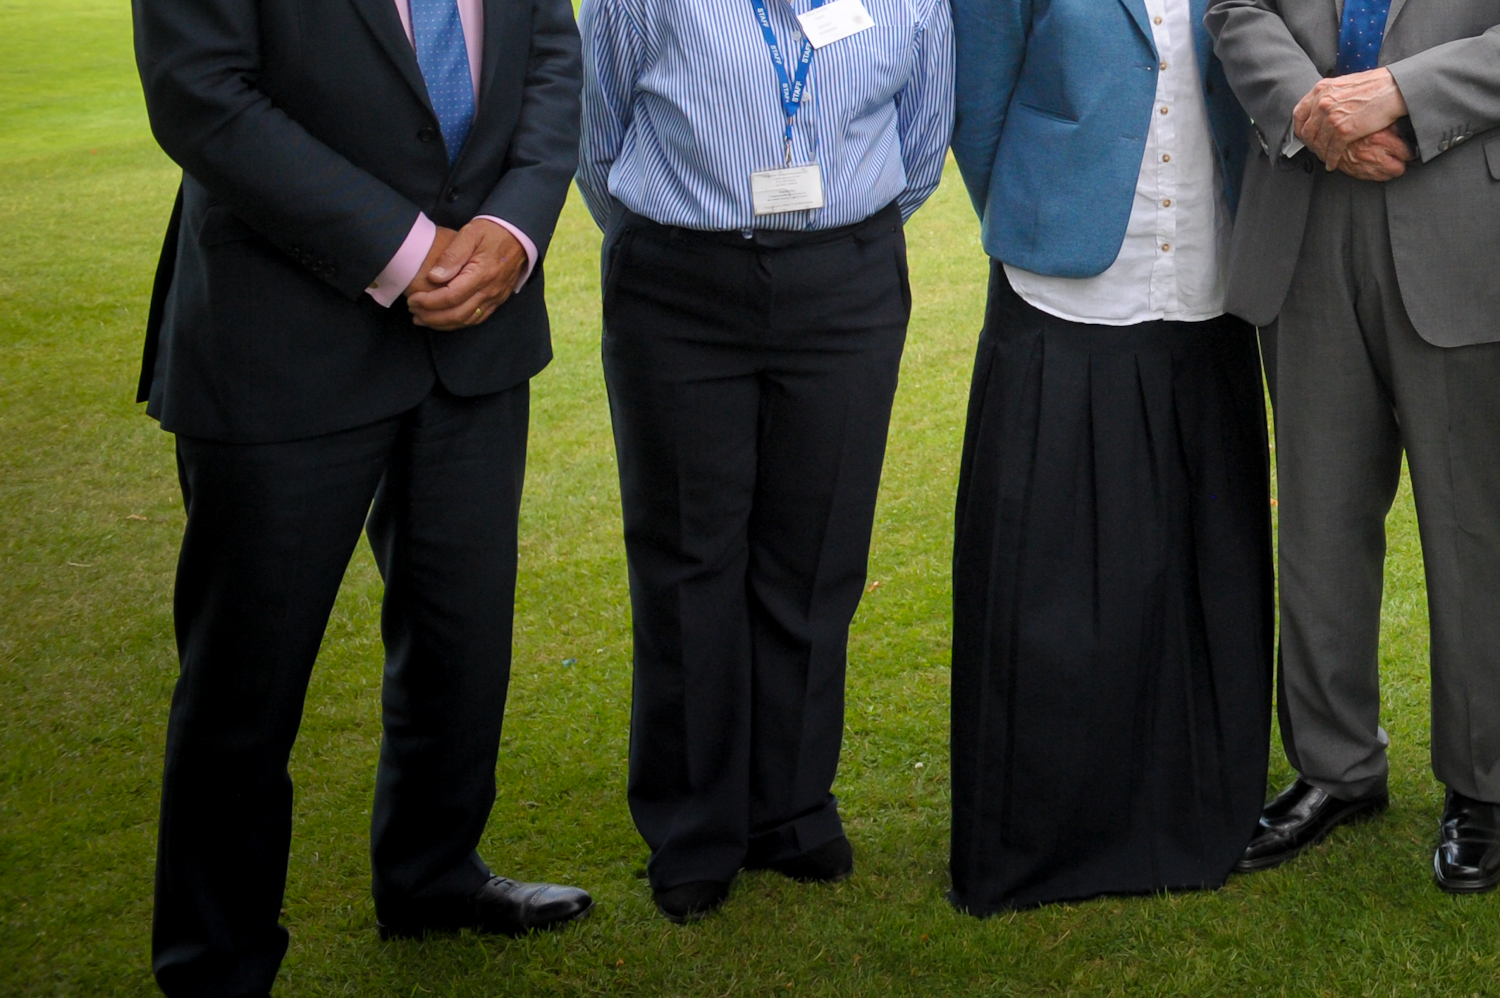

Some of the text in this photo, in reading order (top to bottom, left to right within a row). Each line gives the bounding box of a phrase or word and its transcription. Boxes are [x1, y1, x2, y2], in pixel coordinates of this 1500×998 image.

[757, 8, 769, 28] STAFF
[771, 44, 782, 65] STAFF
[792, 81, 803, 103] STAFF
